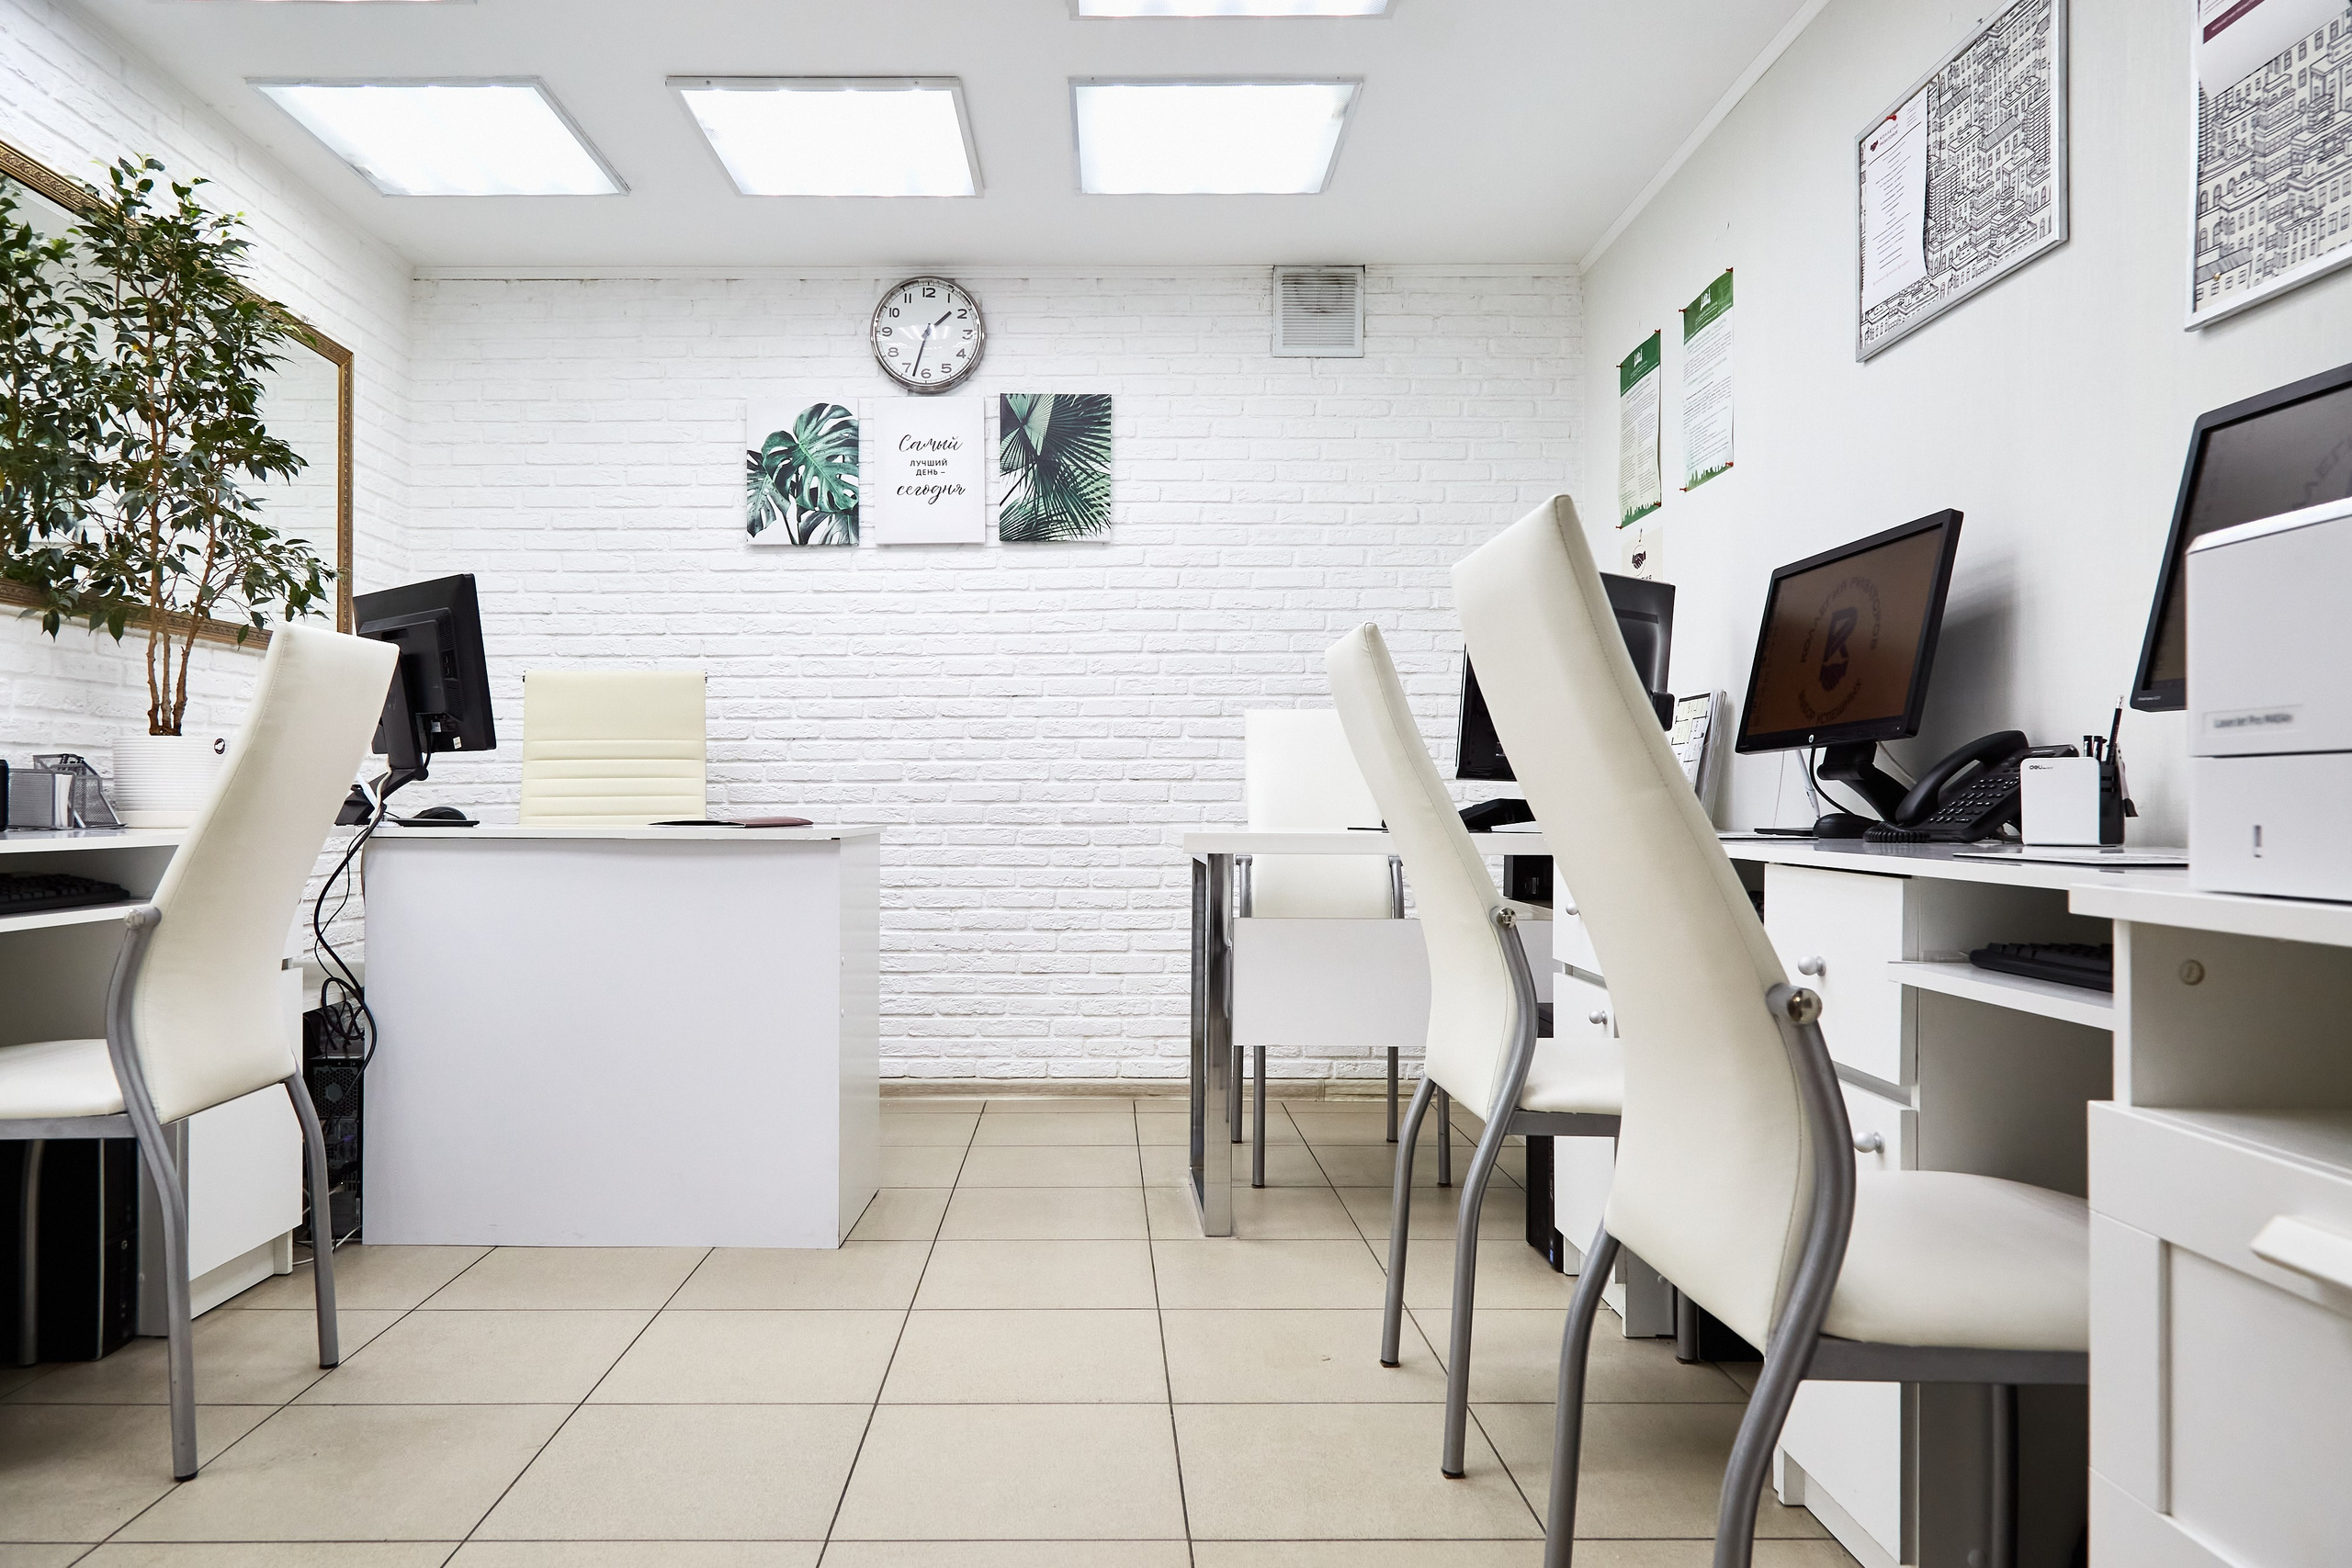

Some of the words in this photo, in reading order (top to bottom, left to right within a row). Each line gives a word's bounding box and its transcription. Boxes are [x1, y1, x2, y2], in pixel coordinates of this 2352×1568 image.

[904, 293, 911, 303] 11
[922, 288, 936, 298] 12
[889, 308, 899, 318] 10
[956, 309, 967, 319] 2
[882, 327, 892, 336] 9
[962, 329, 973, 340] 3
[888, 347, 899, 357] 8
[956, 348, 966, 358] 4
[901, 363, 911, 373] 7
[921, 368, 932, 378] 6
[941, 363, 952, 373] 5
[899, 434, 963, 452] Самый
[910, 458, 948, 467] ЛУЧШИЙ
[897, 483, 966, 505] сегодня
